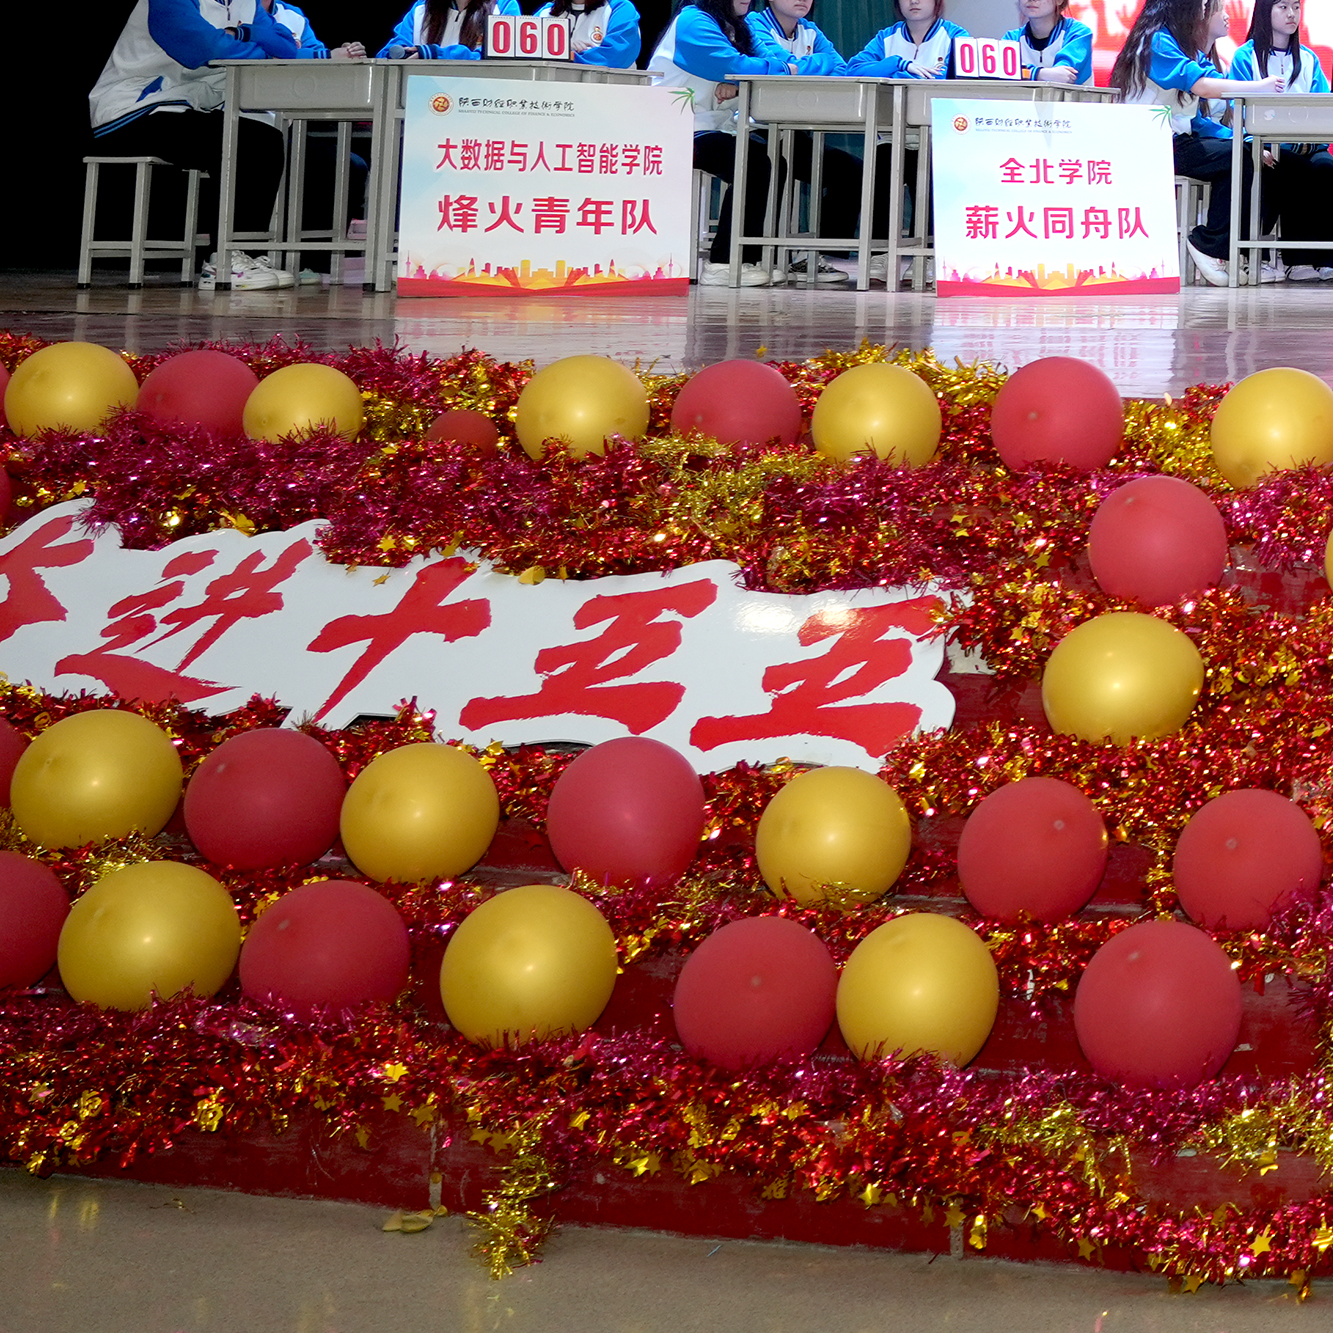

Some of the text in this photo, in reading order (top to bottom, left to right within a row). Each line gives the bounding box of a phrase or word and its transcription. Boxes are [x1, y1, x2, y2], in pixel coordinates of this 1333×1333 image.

[492, 20, 566, 57] 060
[960, 43, 1017, 76] 060
[436, 138, 663, 175] 大数据与人工智能学院
[1000, 157, 1113, 185] 全北学院
[437, 194, 658, 236] 烽火青年队
[965, 205, 1149, 239] 薪火同舟队
